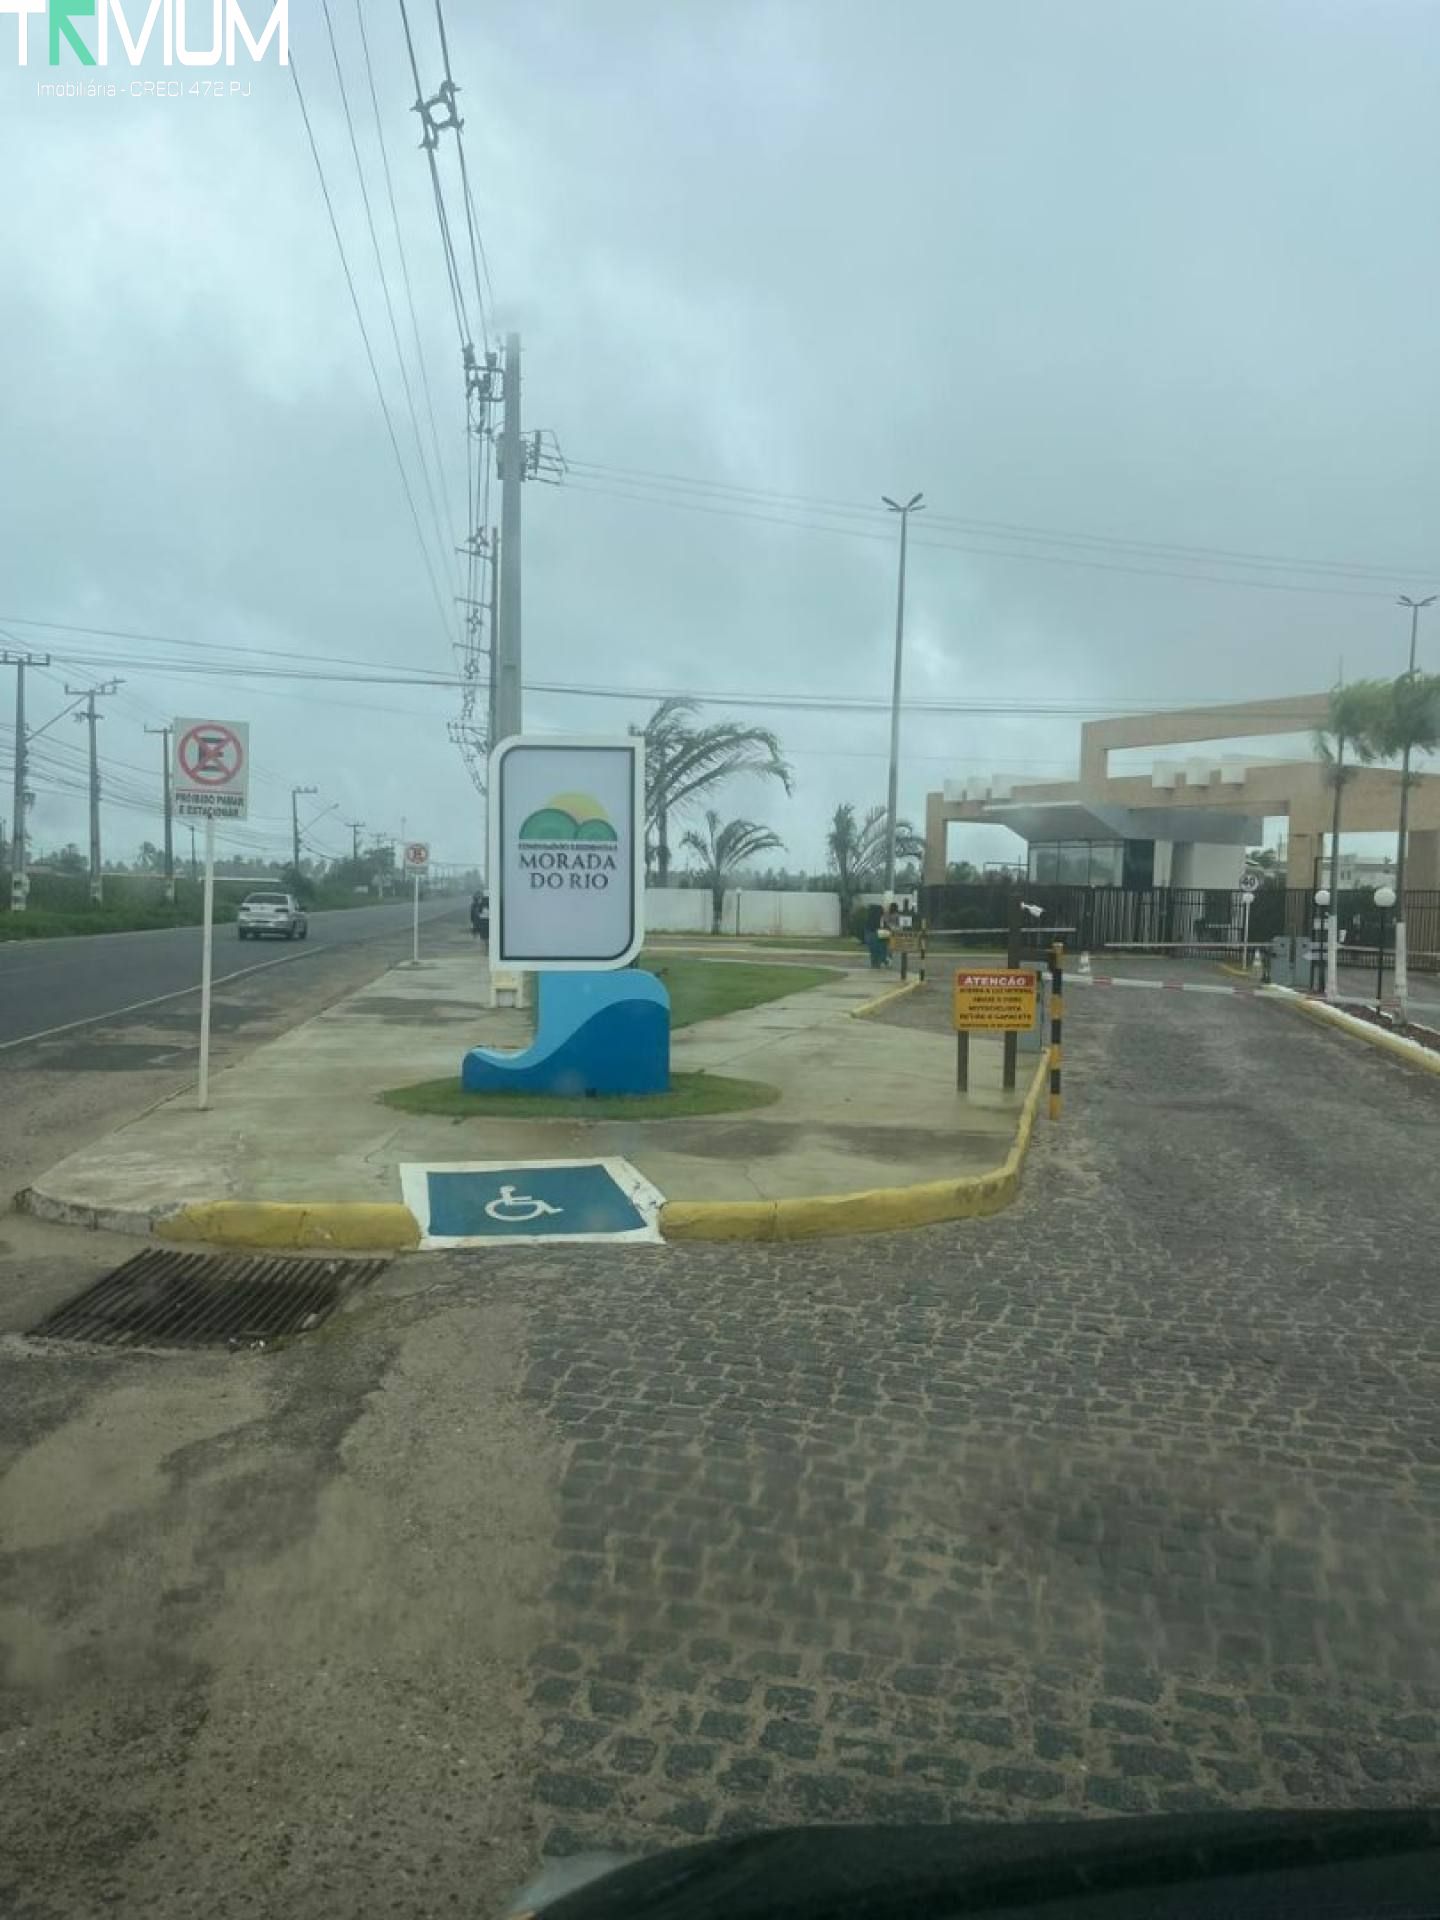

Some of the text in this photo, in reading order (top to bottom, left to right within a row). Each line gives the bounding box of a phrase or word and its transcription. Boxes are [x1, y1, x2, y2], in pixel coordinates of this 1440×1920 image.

[519, 852, 617, 870] MORADA
[529, 872, 609, 890] DO RIO
